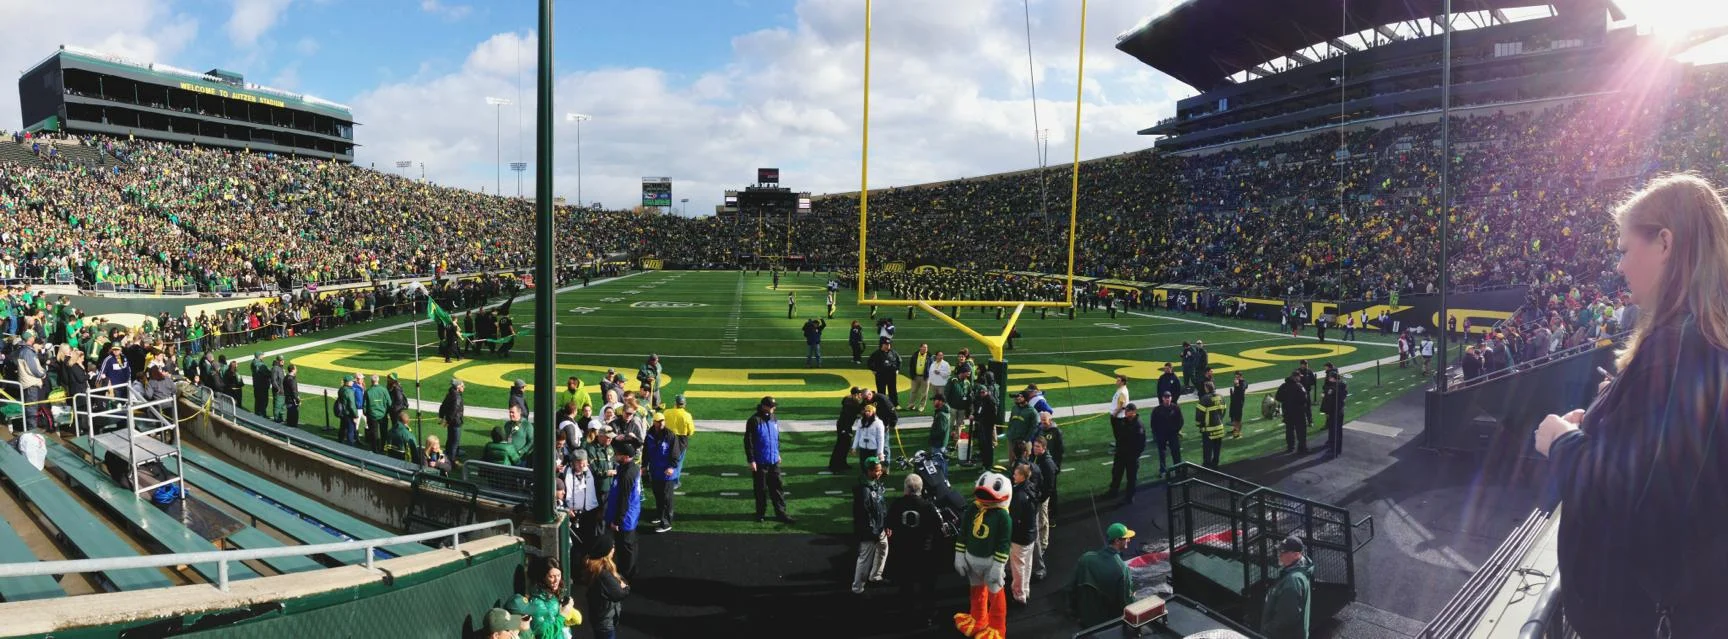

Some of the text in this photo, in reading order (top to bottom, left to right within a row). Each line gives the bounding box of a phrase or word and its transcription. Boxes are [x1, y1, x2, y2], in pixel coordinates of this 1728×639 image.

[180, 82, 216, 95] WELCOME
[219, 89, 228, 98] TO
[260, 97, 284, 107] STADIUM
